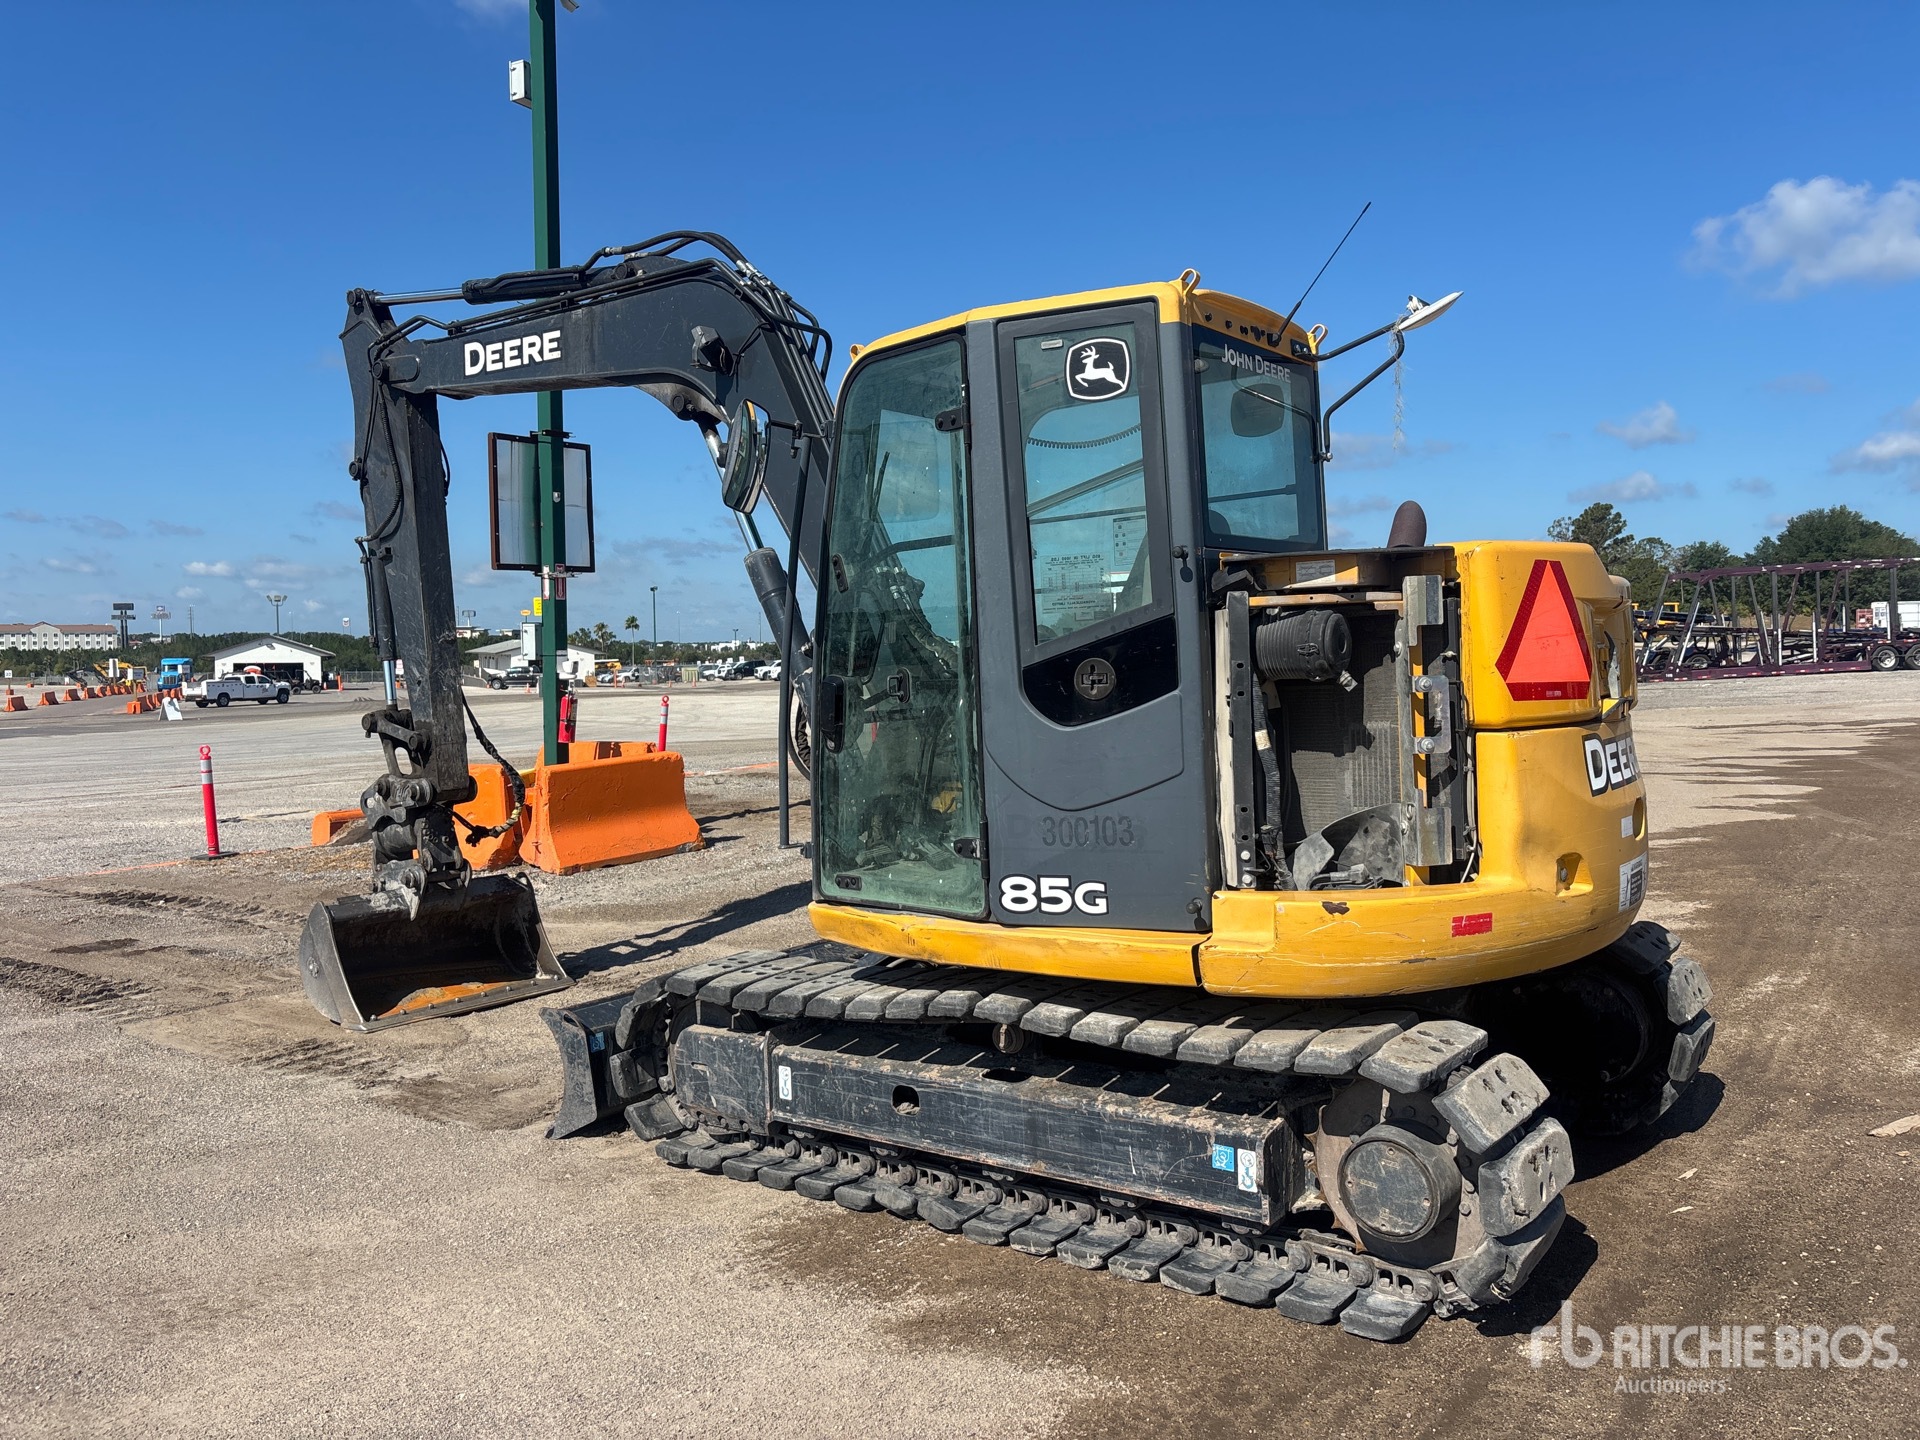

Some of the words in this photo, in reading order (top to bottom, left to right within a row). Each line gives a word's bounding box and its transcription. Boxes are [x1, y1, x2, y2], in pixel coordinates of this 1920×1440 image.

[464, 329, 562, 377] DEERE
[1221, 343, 1253, 371] JOHN
[1255, 354, 1291, 383] DEERE
[1583, 736, 1639, 792] DEER
[1041, 814, 1135, 848] 300103
[1000, 875, 1109, 915] 85G
